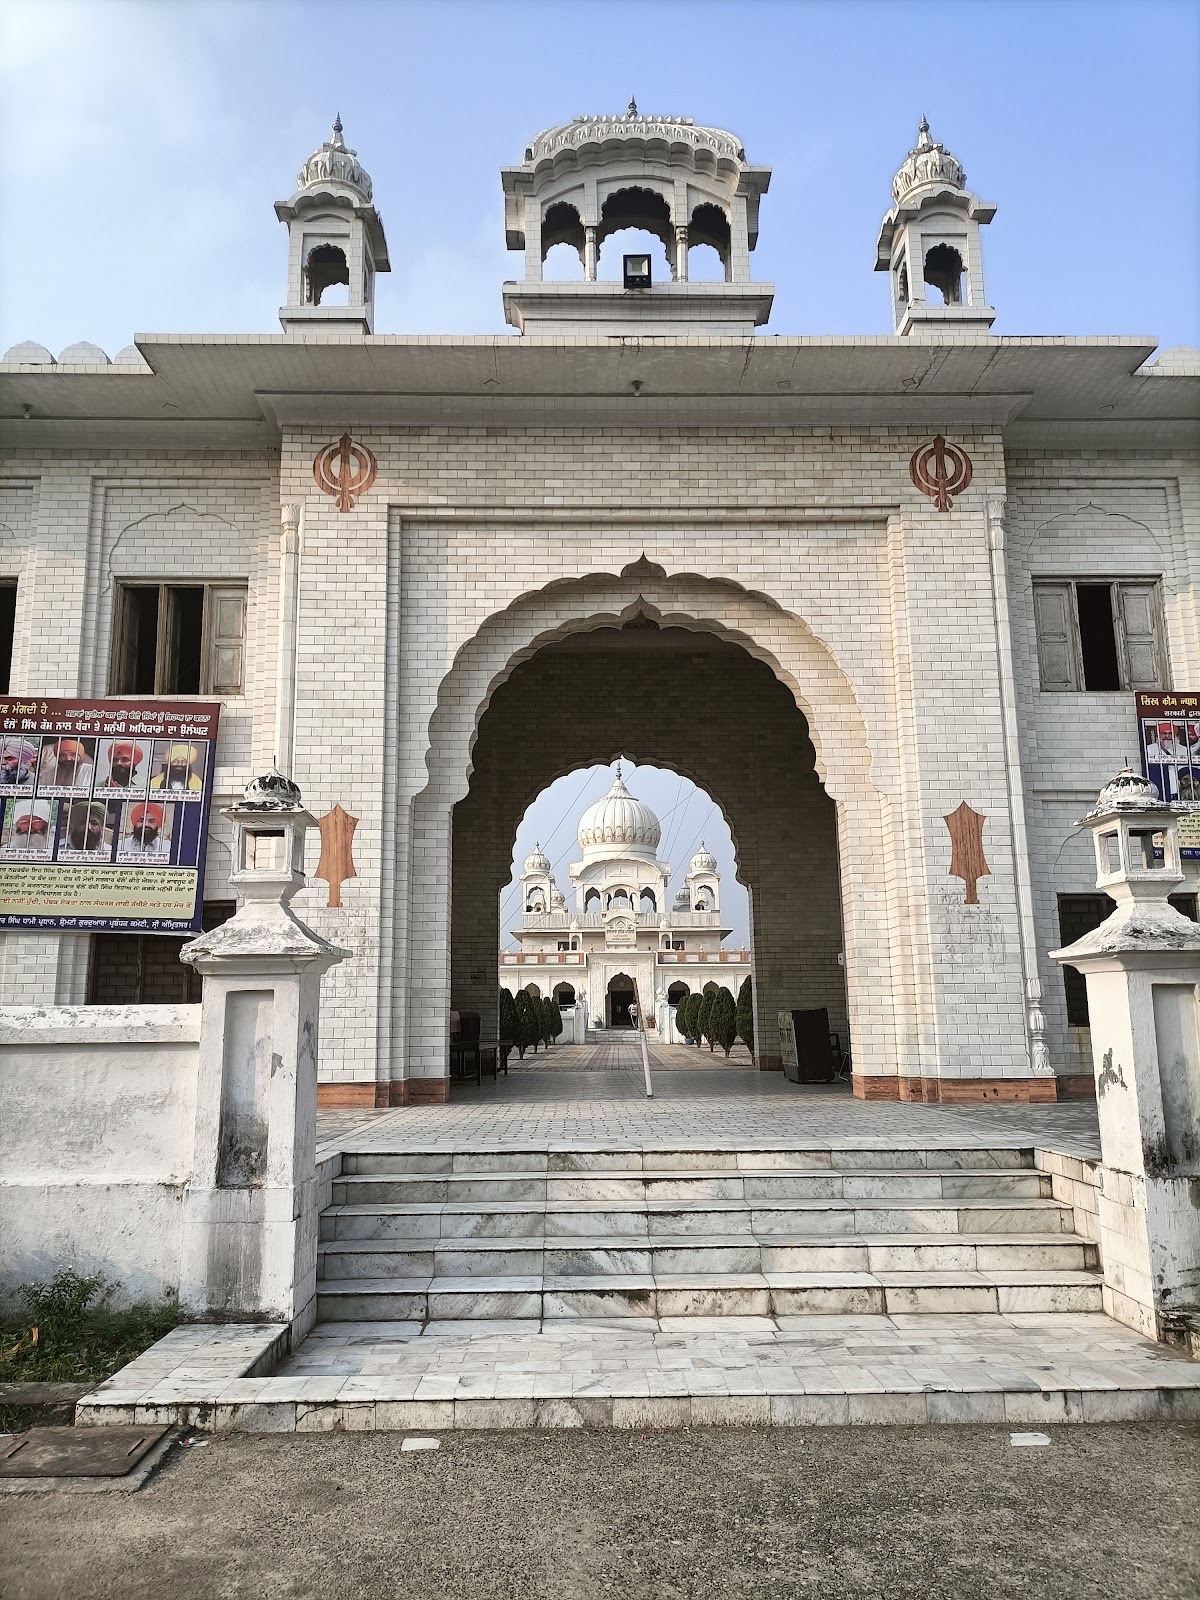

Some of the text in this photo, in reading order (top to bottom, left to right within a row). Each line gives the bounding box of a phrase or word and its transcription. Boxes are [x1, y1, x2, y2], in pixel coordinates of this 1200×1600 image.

[1140, 695, 1159, 705] सिख
[1180, 698, 1197, 706] न्याय
[12, 702, 37, 714] ਮੰਗਦੀ
[41, 702, 48, 714] ਹੈ
[4, 718, 18, 729] ਵੱਲੋਂ
[21, 718, 37, 730] ਸਿੱਖ
[40, 718, 52, 730] ਕੌਮ
[56, 722, 72, 730] ਨਾਲ
[76, 720, 90, 731] ਧੱਕਾ
[94, 721, 100, 732] ਤੇ
[104, 722, 125, 734] ਮਨੁੱਖੀ
[129, 722, 164, 734] ਅਧਿਕਾਰਾਂ
[168, 726, 177, 734] ਦਾ
[8, 916, 20, 924] ਸਿੰਘ
